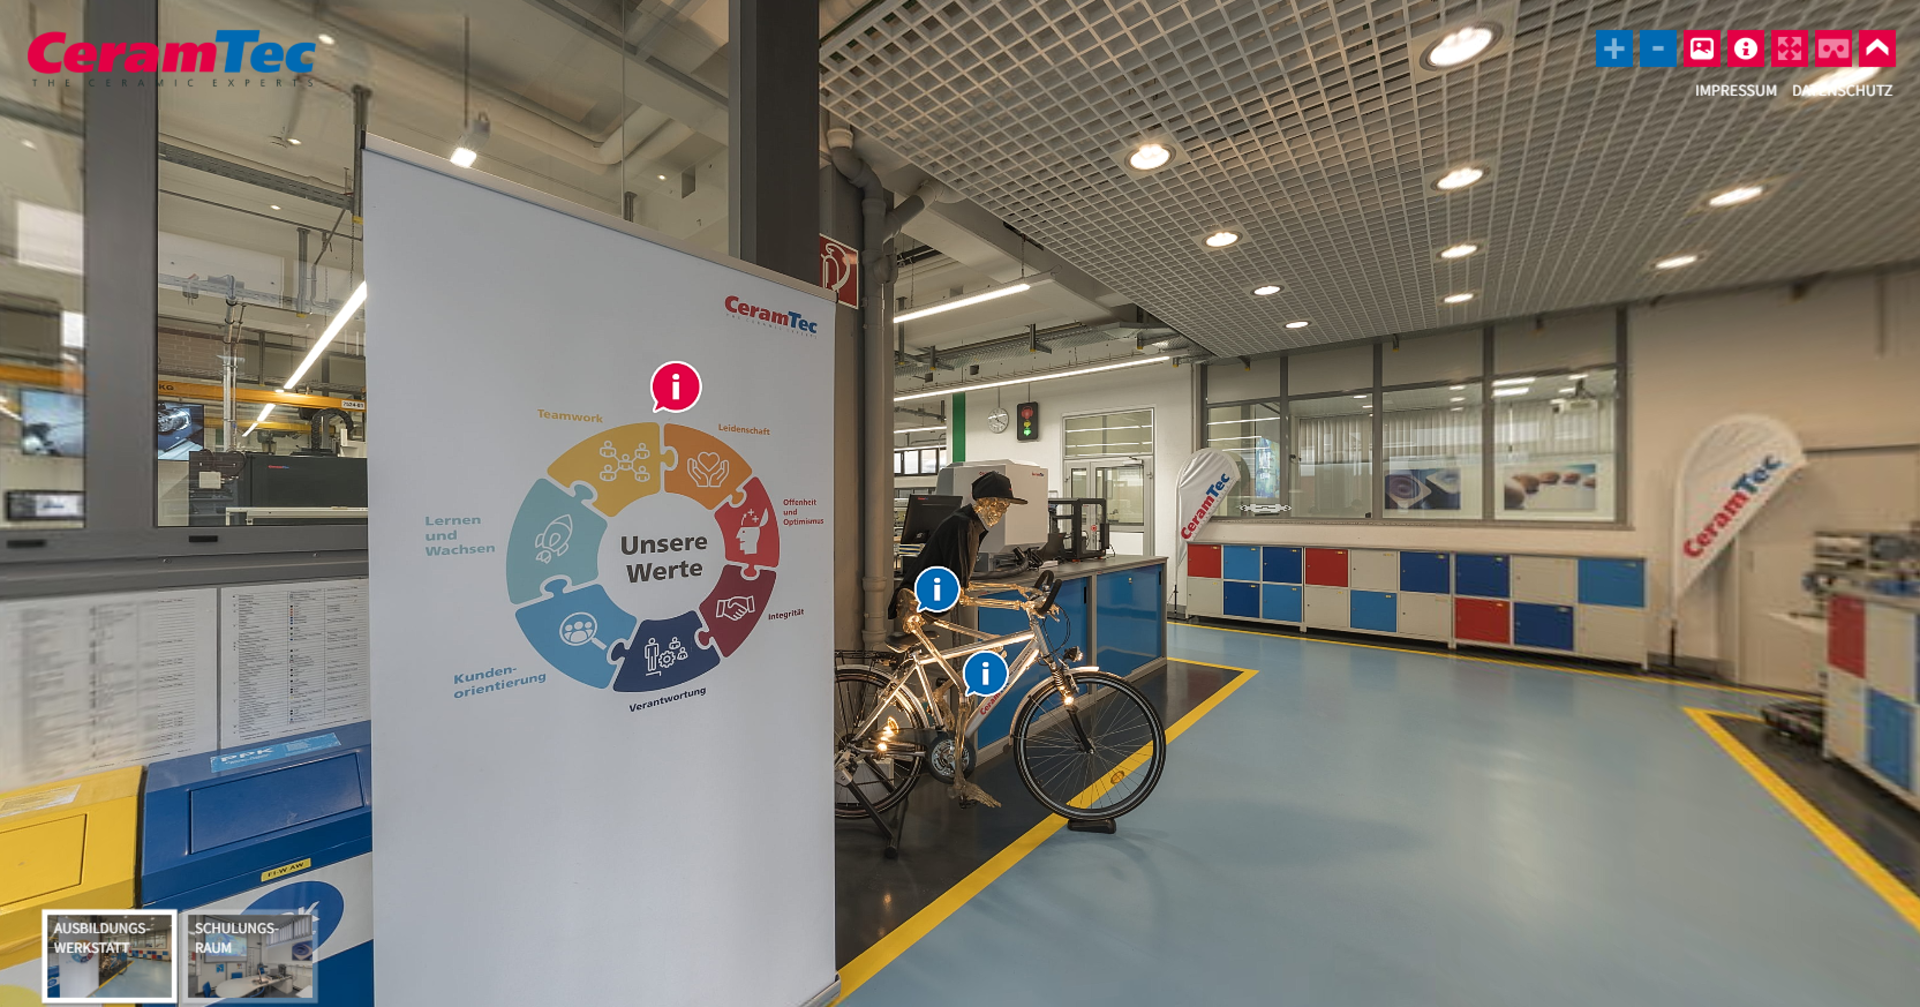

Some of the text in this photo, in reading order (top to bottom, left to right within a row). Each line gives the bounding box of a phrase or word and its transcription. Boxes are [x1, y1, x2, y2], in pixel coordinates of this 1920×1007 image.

[725, 295, 818, 334] CeramTec
[537, 409, 603, 423] Teamwork
[718, 423, 771, 436] Leidenschaft
[783, 498, 817, 506] Offenheit
[1181, 473, 1231, 539] CeramTec
[1683, 454, 1782, 558] CeramTec
[783, 508, 798, 516] und
[425, 516, 481, 526] Lernen
[783, 518, 824, 526] Optimismus
[425, 530, 457, 541] und
[425, 544, 496, 557] Wachsen
[620, 535, 708, 556] Unsere
[626, 560, 703, 583] Werte
[768, 608, 805, 621] Integrität
[453, 666, 517, 684] Kunden-
[453, 673, 546, 699] orientierung
[628, 687, 707, 713] Verantwortung
[979, 682, 1010, 716] Ceram
